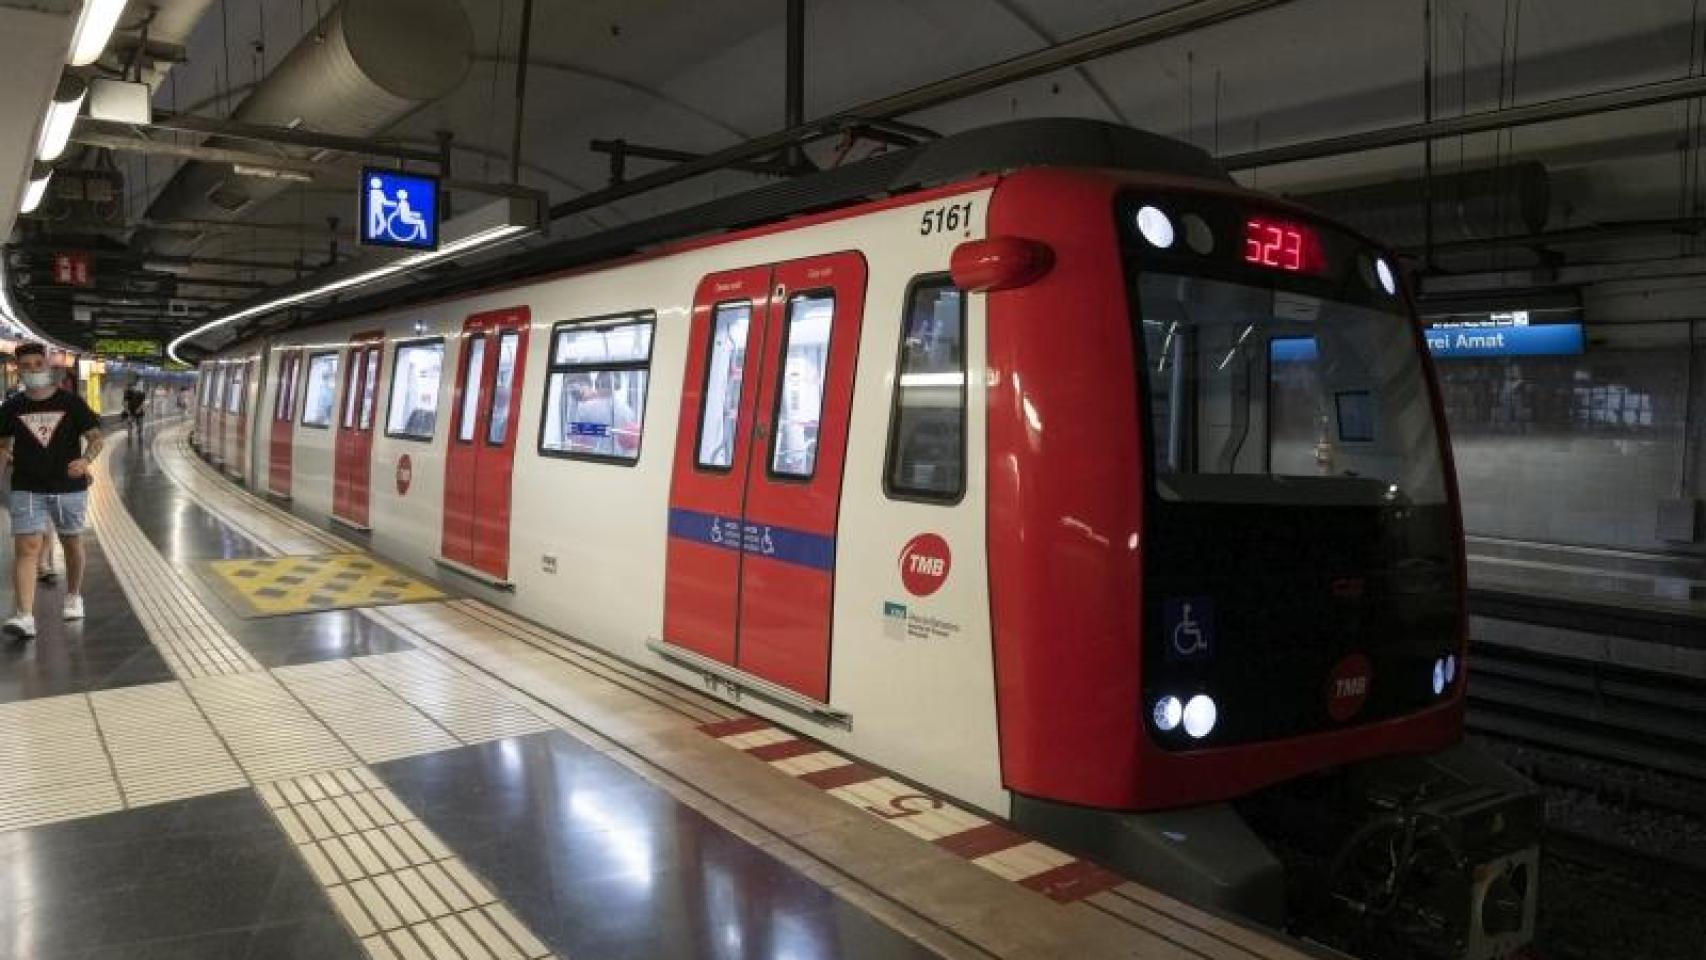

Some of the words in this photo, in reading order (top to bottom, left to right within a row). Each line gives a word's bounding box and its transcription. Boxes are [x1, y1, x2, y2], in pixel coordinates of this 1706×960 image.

[920, 200, 973, 235] 5161
[1244, 221, 1303, 270] 523
[1427, 334, 1449, 349] rei
[1456, 332, 1505, 348] Amat
[909, 554, 946, 577] TMB
[1336, 675, 1366, 697] TMB
